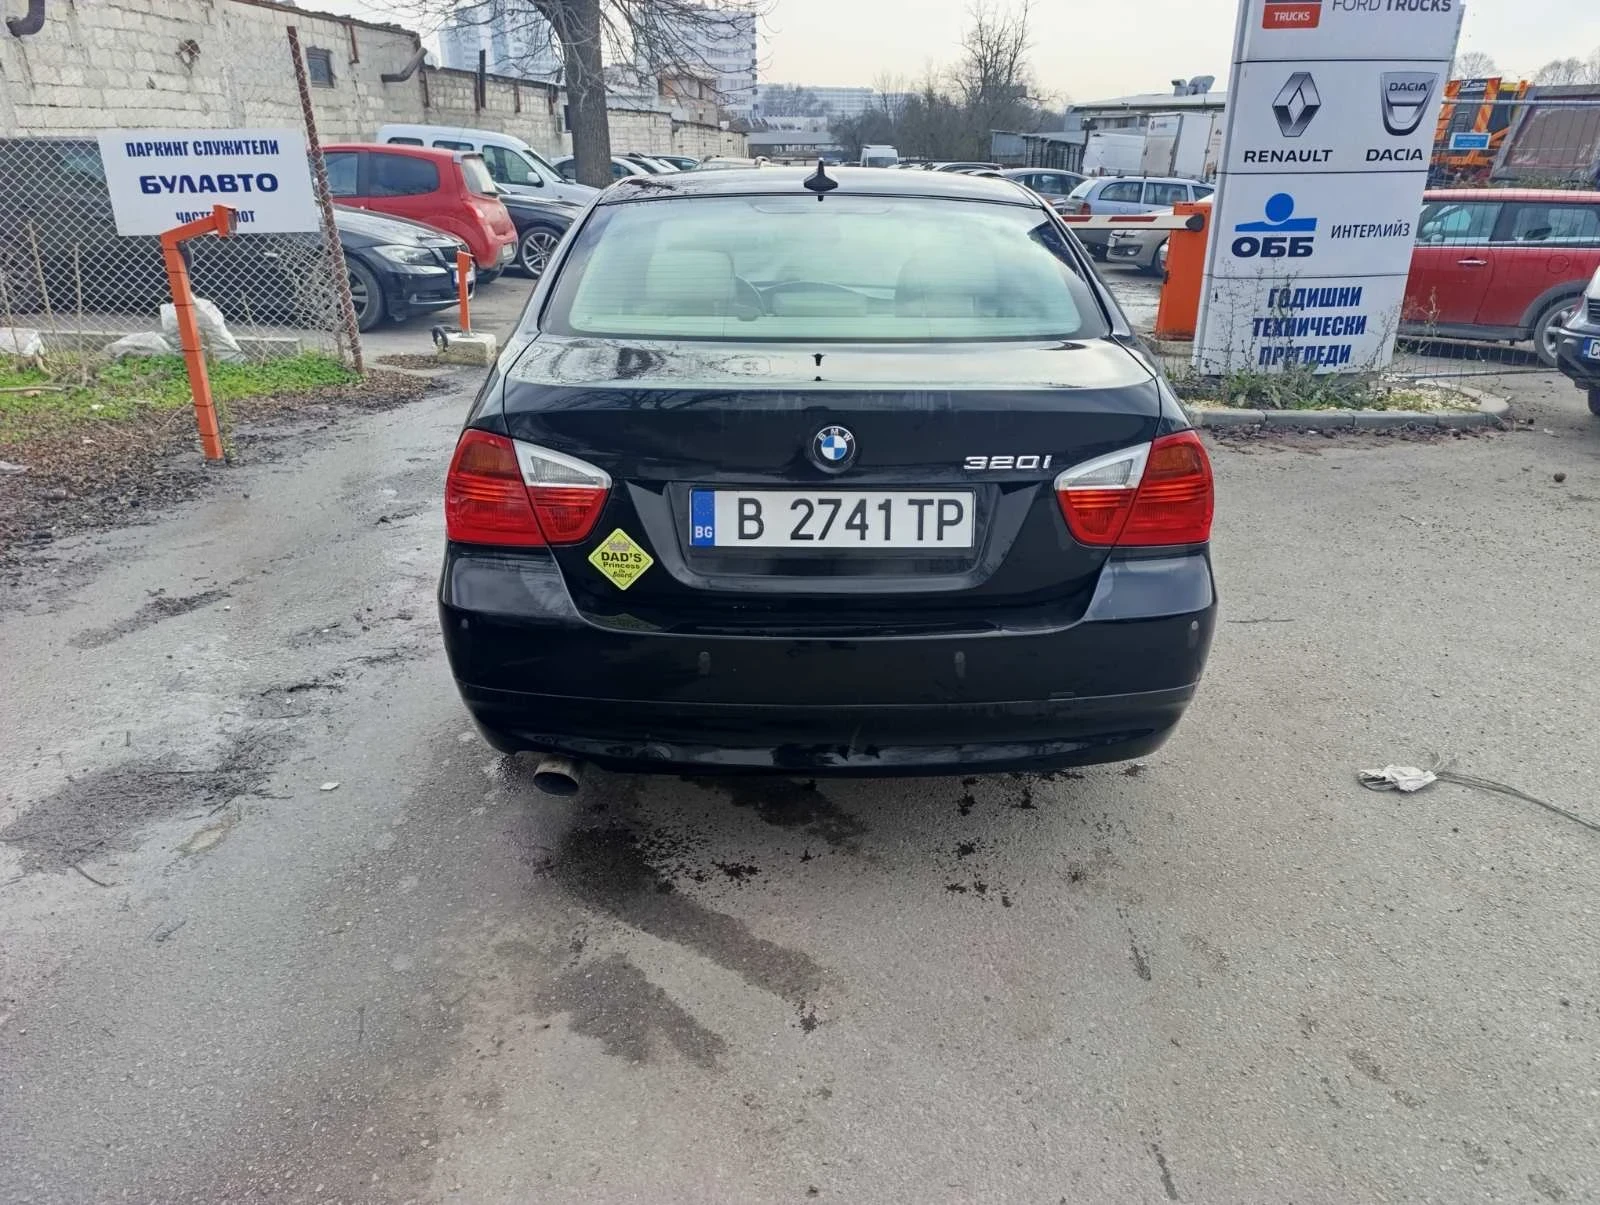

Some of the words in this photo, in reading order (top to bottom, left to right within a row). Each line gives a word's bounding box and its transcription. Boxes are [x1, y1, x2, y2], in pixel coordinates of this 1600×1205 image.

[1332, 0, 1380, 12] FORD
[1385, 0, 1451, 13] TRUCKS
[1273, 11, 1311, 22] TRUCKS
[1388, 82, 1428, 92] DACIA
[125, 141, 189, 157] ПАРКИНГ
[193, 139, 280, 156] СЛУЖИТЕЛИ
[1365, 148, 1423, 162] DACIA
[1243, 149, 1333, 163] RENAULT
[139, 173, 279, 194] БУЛАВТО
[1331, 219, 1410, 239] ИНТЕРЛИЙЗ
[1231, 236, 1314, 258] ОББ
[1267, 287, 1363, 311] ГОДИШНИ
[1253, 315, 1367, 337] ТЕХНИЧЕСКИ
[817, 428, 852, 441] BMW
[737, 497, 765, 540] B
[789, 498, 892, 541] 2741
[907, 498, 965, 541] TP
[694, 526, 713, 539] BG
[601, 552, 642, 562] DAD'S
[603, 561, 640, 569] Princess
